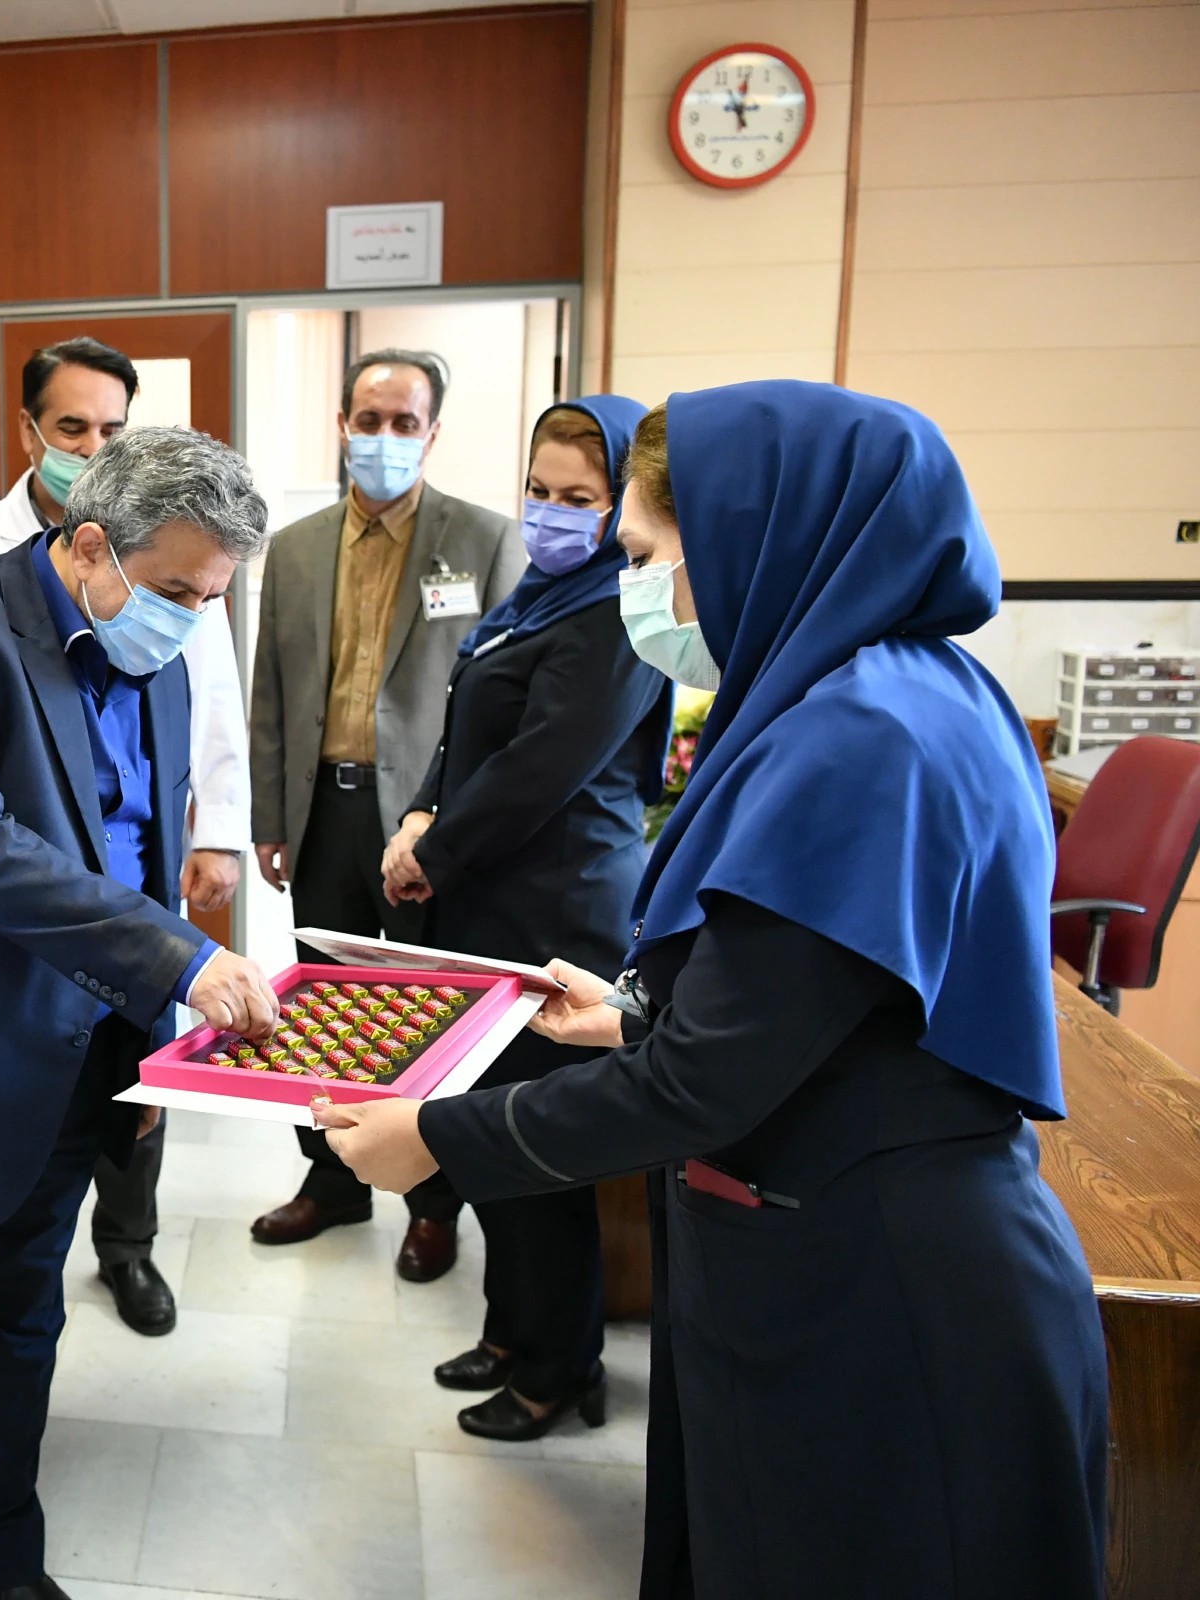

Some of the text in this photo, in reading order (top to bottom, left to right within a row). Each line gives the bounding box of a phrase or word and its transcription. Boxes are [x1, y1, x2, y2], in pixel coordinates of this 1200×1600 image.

[715, 68, 728, 86] 11
[736, 65, 753, 78] 12
[764, 69, 770, 82] 1
[697, 89, 711, 104] 10
[776, 84, 787, 97] 2
[689, 111, 699, 125] 9
[784, 108, 794, 122] 3
[694, 132, 706, 147] 8
[774, 130, 784, 143] 4
[710, 149, 721, 164] 7
[732, 154, 743, 168] 6
[756, 149, 765, 161] 5
